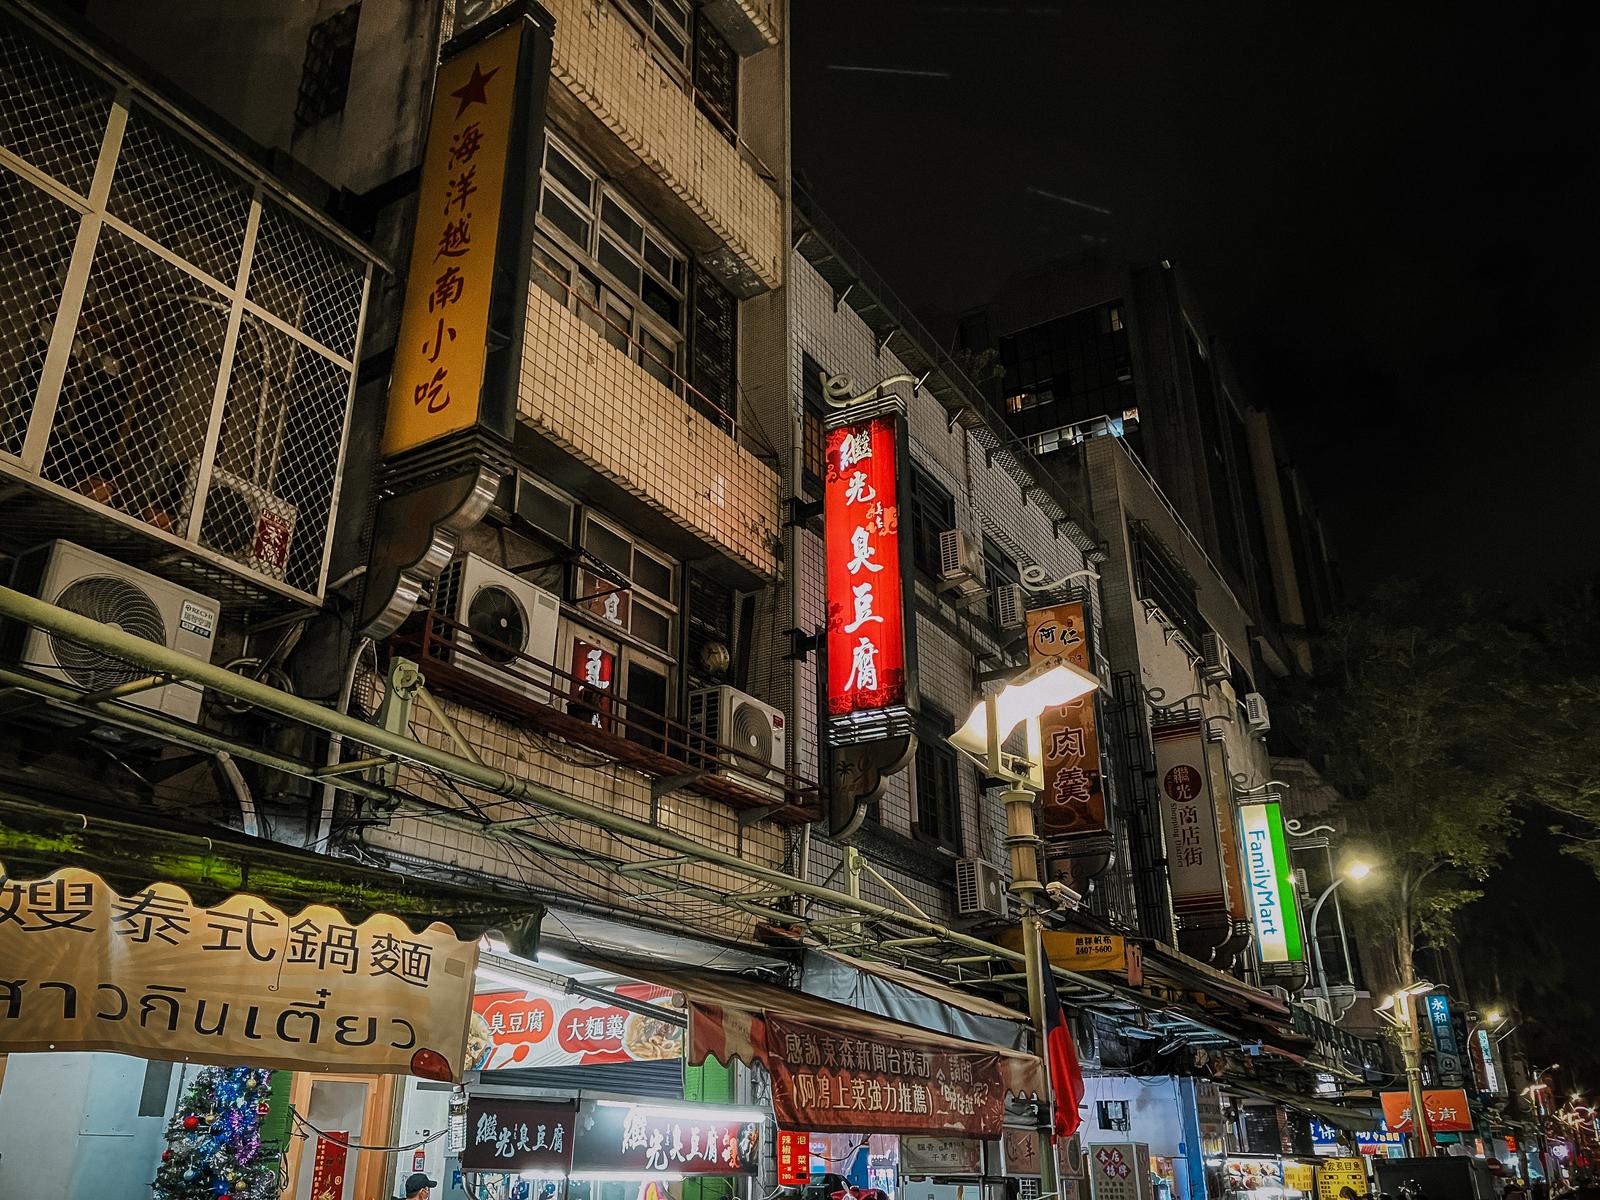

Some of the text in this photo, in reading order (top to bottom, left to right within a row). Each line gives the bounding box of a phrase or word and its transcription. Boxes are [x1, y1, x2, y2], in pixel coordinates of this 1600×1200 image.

[414, 121, 485, 415] 海洋越南小吃
[839, 430, 884, 692] 繼光臭豆腐
[1039, 626, 1080, 645] 阿仁
[1178, 805, 1203, 867] 商店街
[1249, 830, 1278, 935] FamilyMart
[488, 1008, 545, 1036] 臭豆腐
[566, 1014, 625, 1042] 大麵羹
[475, 1112, 565, 1158] 繼光臭豆腐
